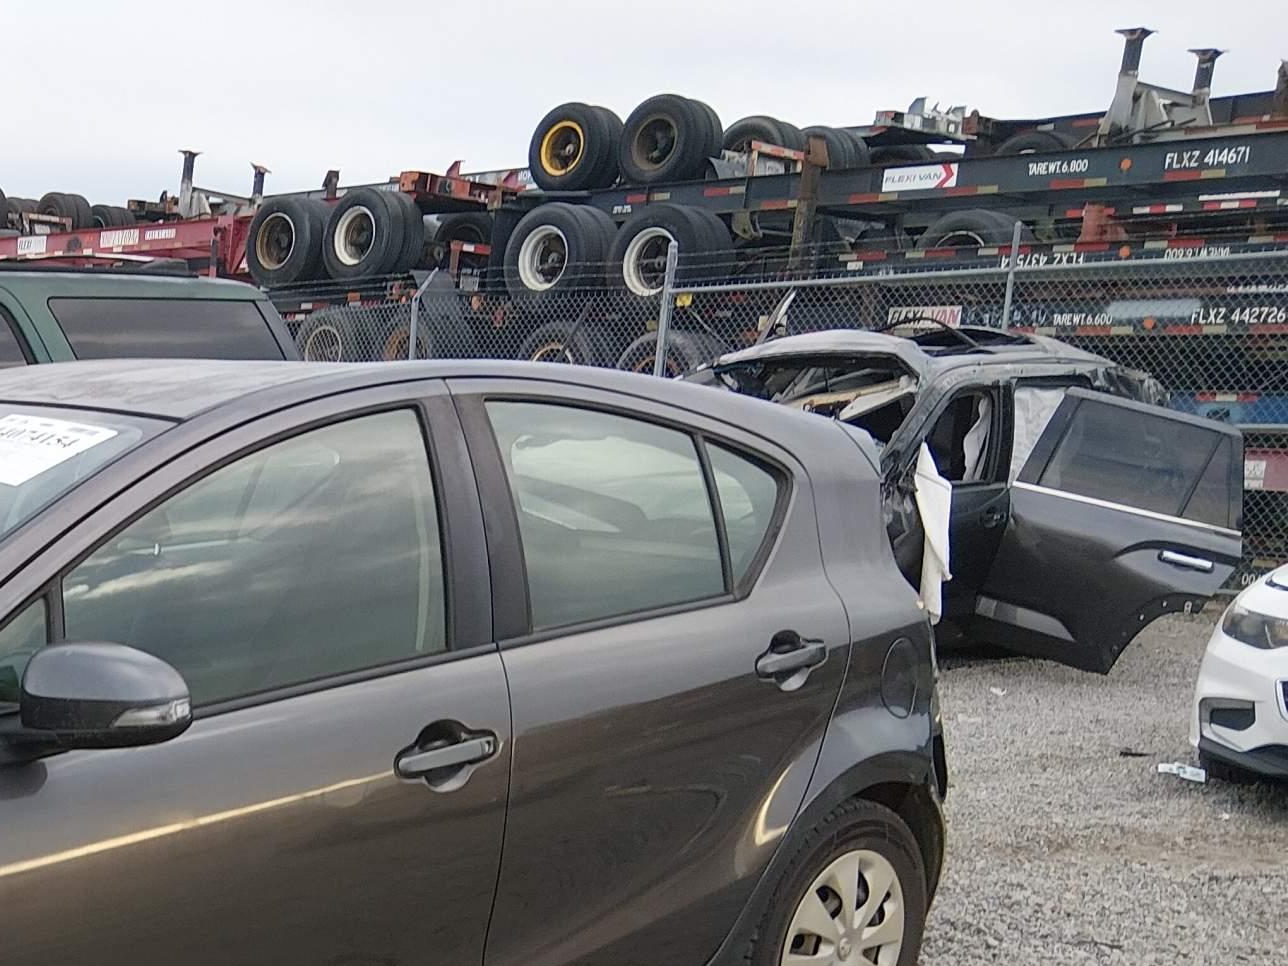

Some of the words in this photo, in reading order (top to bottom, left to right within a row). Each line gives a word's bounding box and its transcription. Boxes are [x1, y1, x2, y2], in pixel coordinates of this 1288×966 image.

[1165, 151, 1199, 170] FLXZ
[1204, 146, 1251, 167] 414671
[1000, 253, 1048, 270] 43754
[1191, 307, 1226, 325] FLXZ
[1231, 306, 1286, 324] 442726
